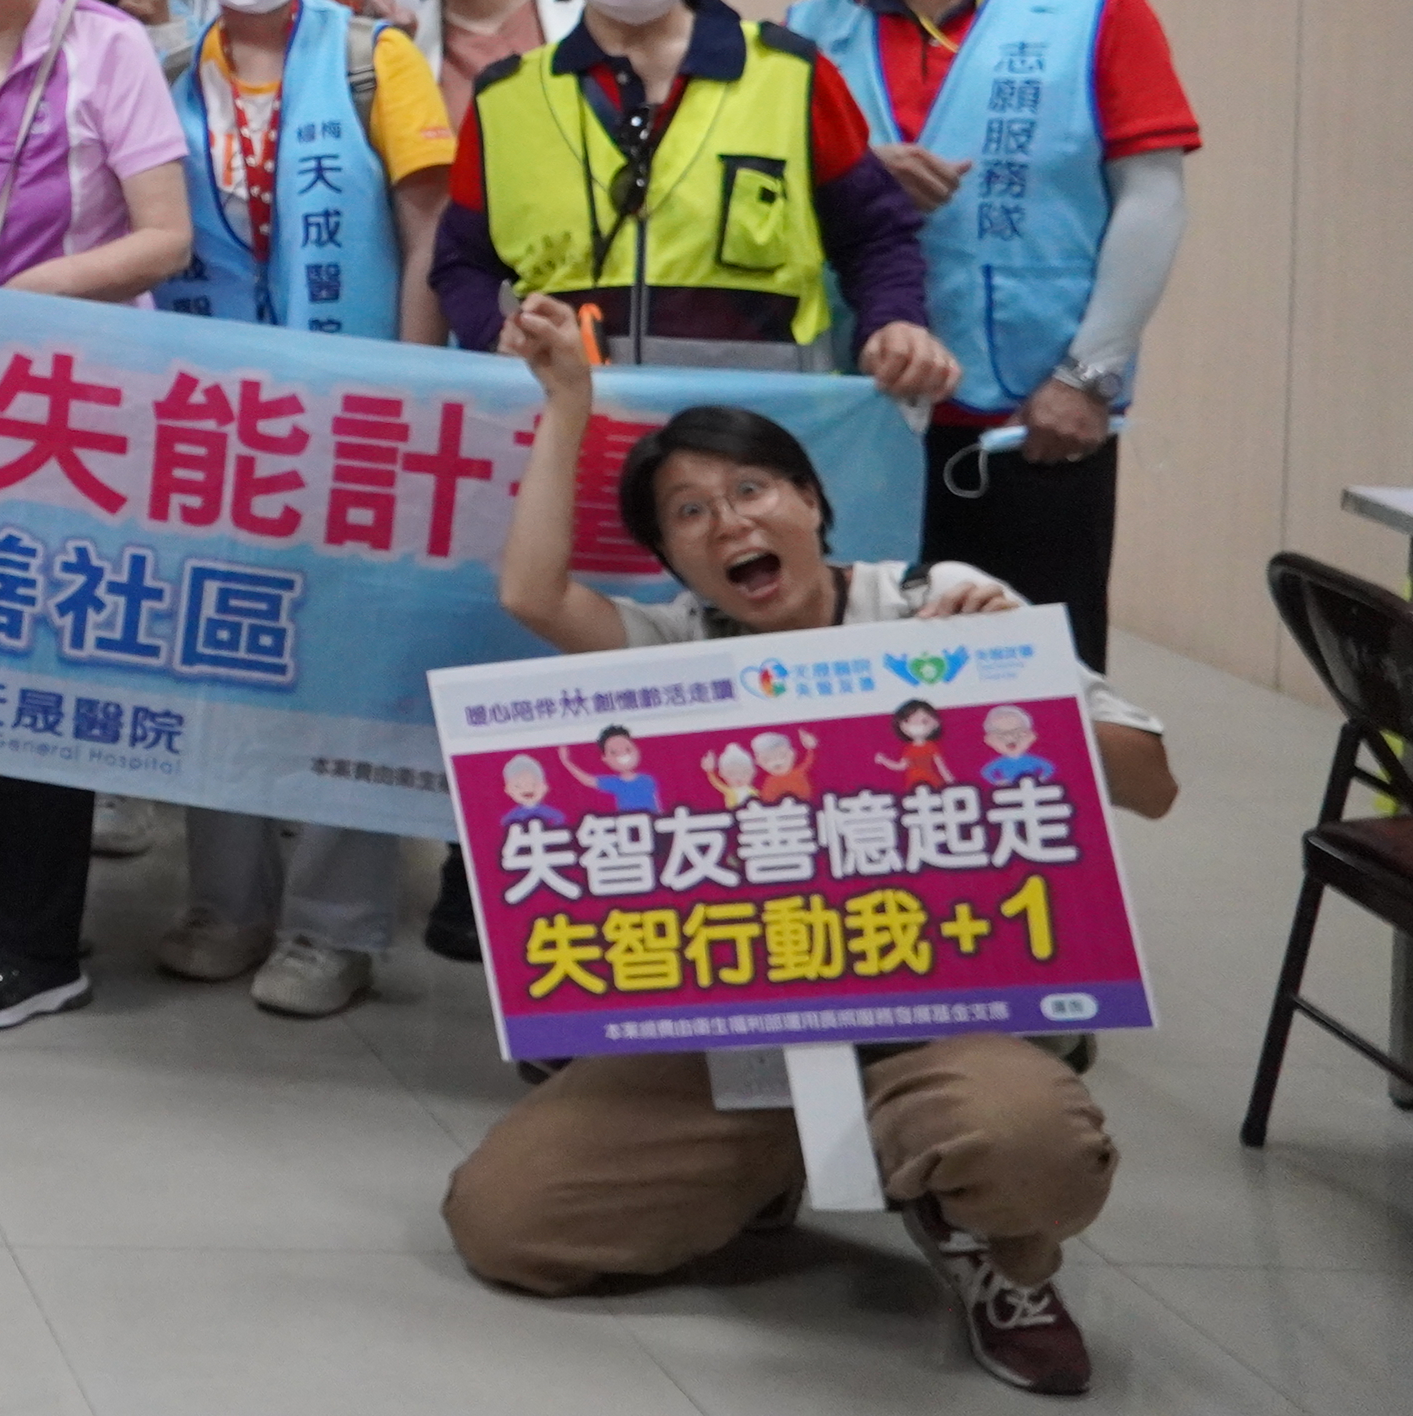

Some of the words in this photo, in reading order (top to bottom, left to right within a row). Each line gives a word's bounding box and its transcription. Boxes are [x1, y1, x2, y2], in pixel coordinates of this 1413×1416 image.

[955, 41, 1050, 241] 志願服務隊
[88, 747, 182, 776] Hospital
[501, 781, 1078, 904] 失智友善憶起走
[525, 875, 1055, 998] 失智行動我+1
